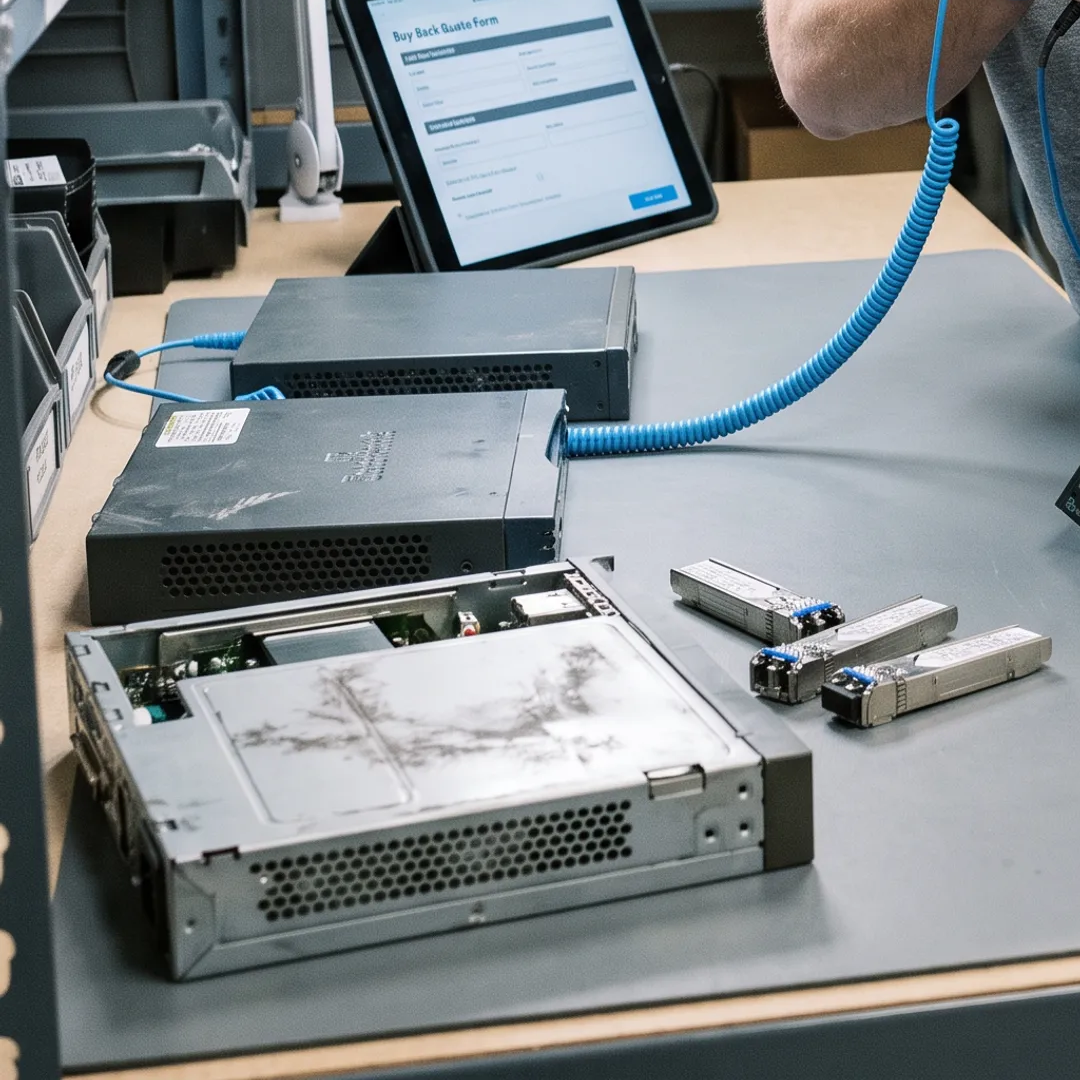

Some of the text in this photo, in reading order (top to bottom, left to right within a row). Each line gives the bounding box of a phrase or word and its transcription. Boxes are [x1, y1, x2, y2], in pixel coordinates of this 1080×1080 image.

[392, 30, 413, 43] Buy
[414, 24, 440, 39] Back
[473, 15, 499, 29] Form
